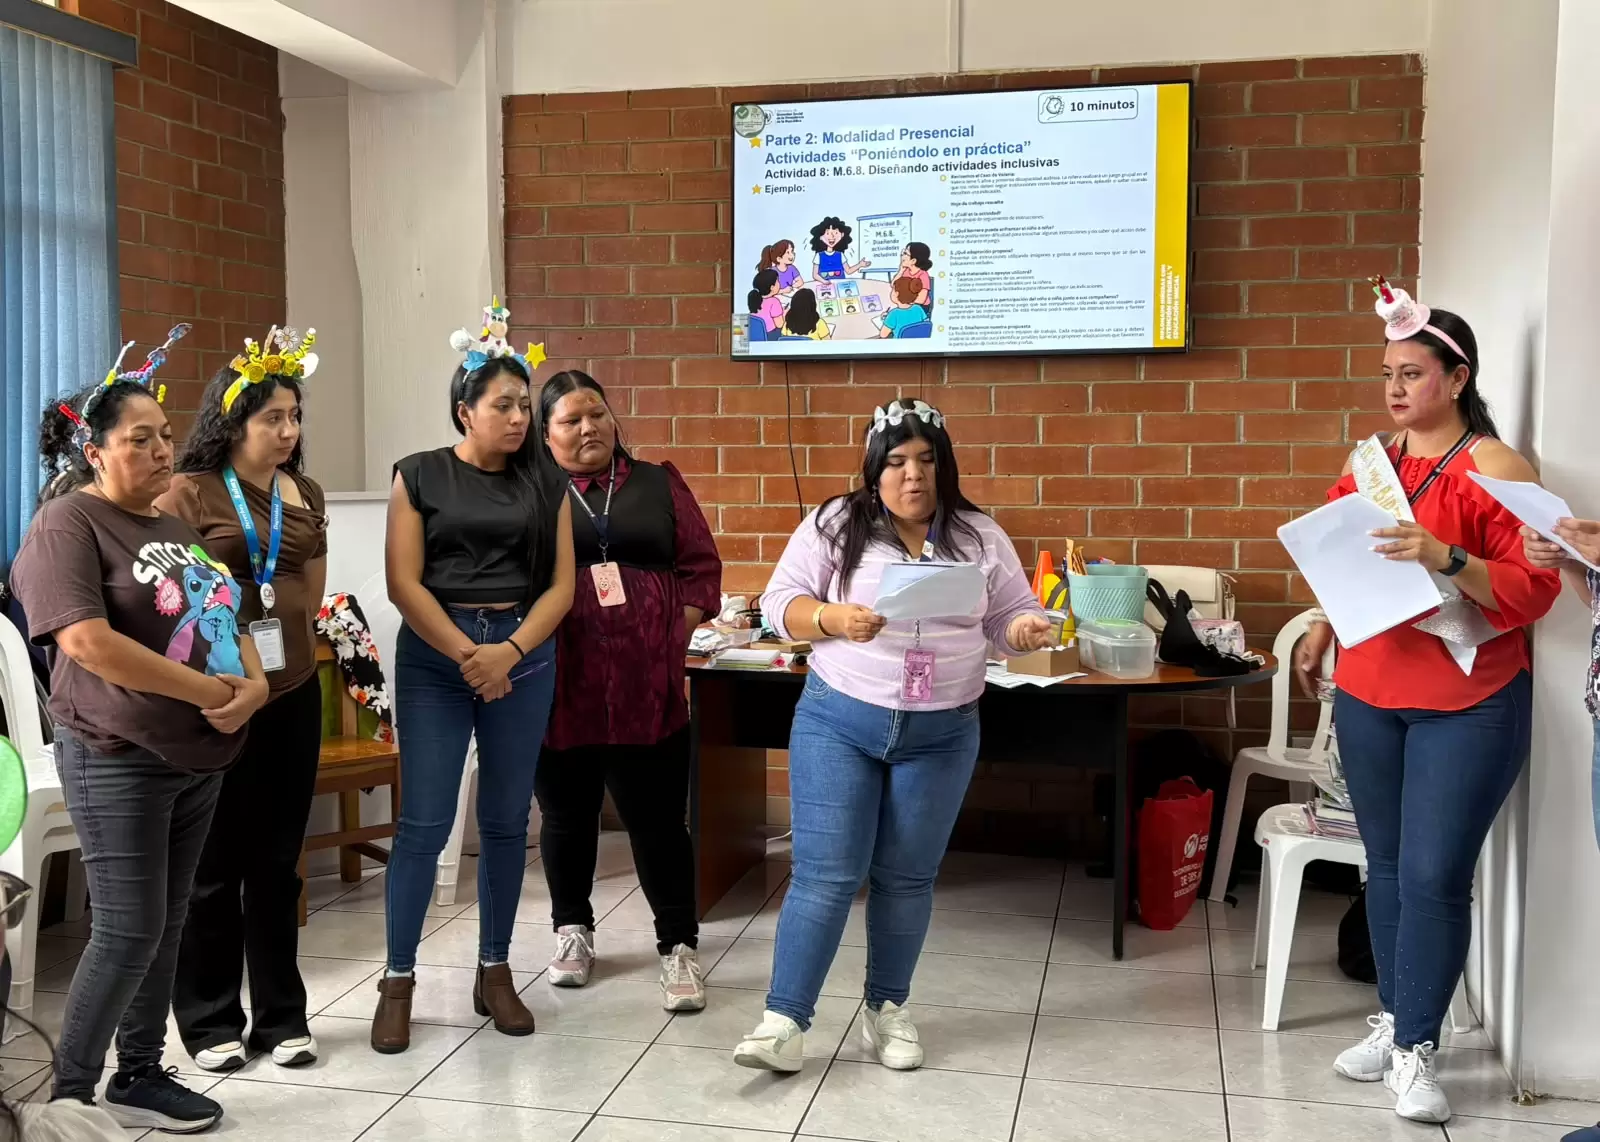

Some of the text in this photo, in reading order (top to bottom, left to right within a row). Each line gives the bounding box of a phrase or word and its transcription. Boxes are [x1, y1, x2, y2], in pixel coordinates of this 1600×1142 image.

[1070, 99, 1135, 112] 10 minutos
[765, 124, 974, 147] Parte 2: Modalidad Presencial
[765, 151, 846, 165] Actividades
[943, 146, 960, 157] en
[765, 157, 1060, 179] Actividad 8: M.6.8. Diseñando actividades inclusivas
[765, 183, 806, 194] Ejemplo:
[132, 541, 206, 587] STITCH
